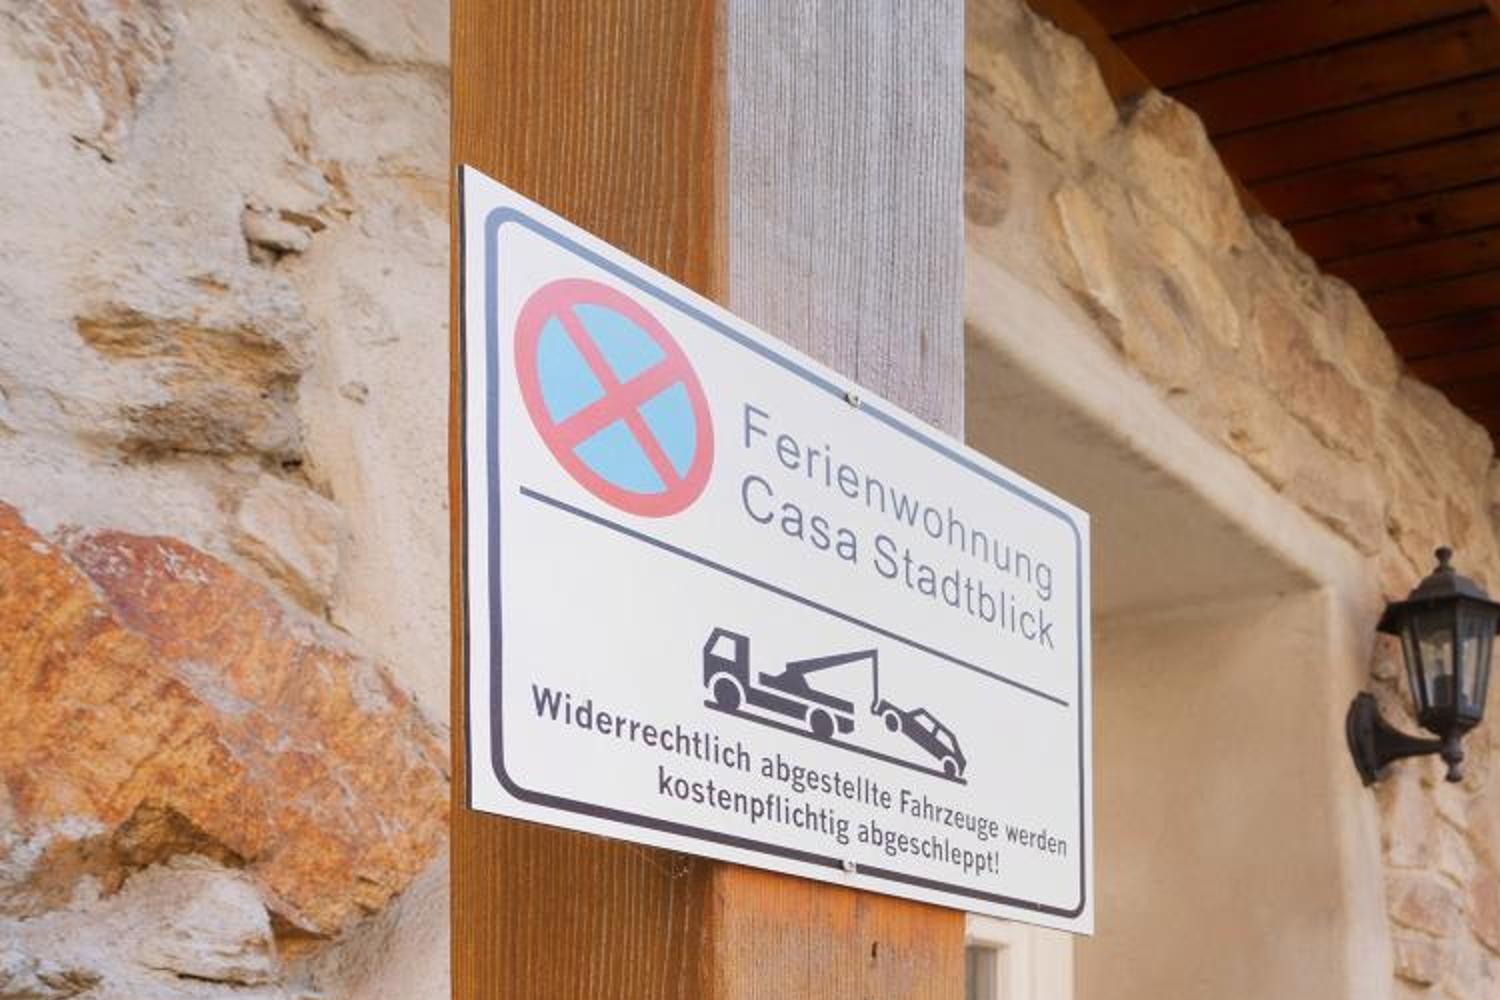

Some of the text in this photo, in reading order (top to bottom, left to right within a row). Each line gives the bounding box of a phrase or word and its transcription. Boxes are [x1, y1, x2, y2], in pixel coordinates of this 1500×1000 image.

[742, 475, 1055, 650] Casa Stadtblick
[744, 404, 1052, 602] Ferienwohnung
[531, 684, 1067, 857] Widerrechtlich abgestellte Fahrzeuge werden
[658, 765, 999, 876] kostenpflichtig abgeschleppt!
